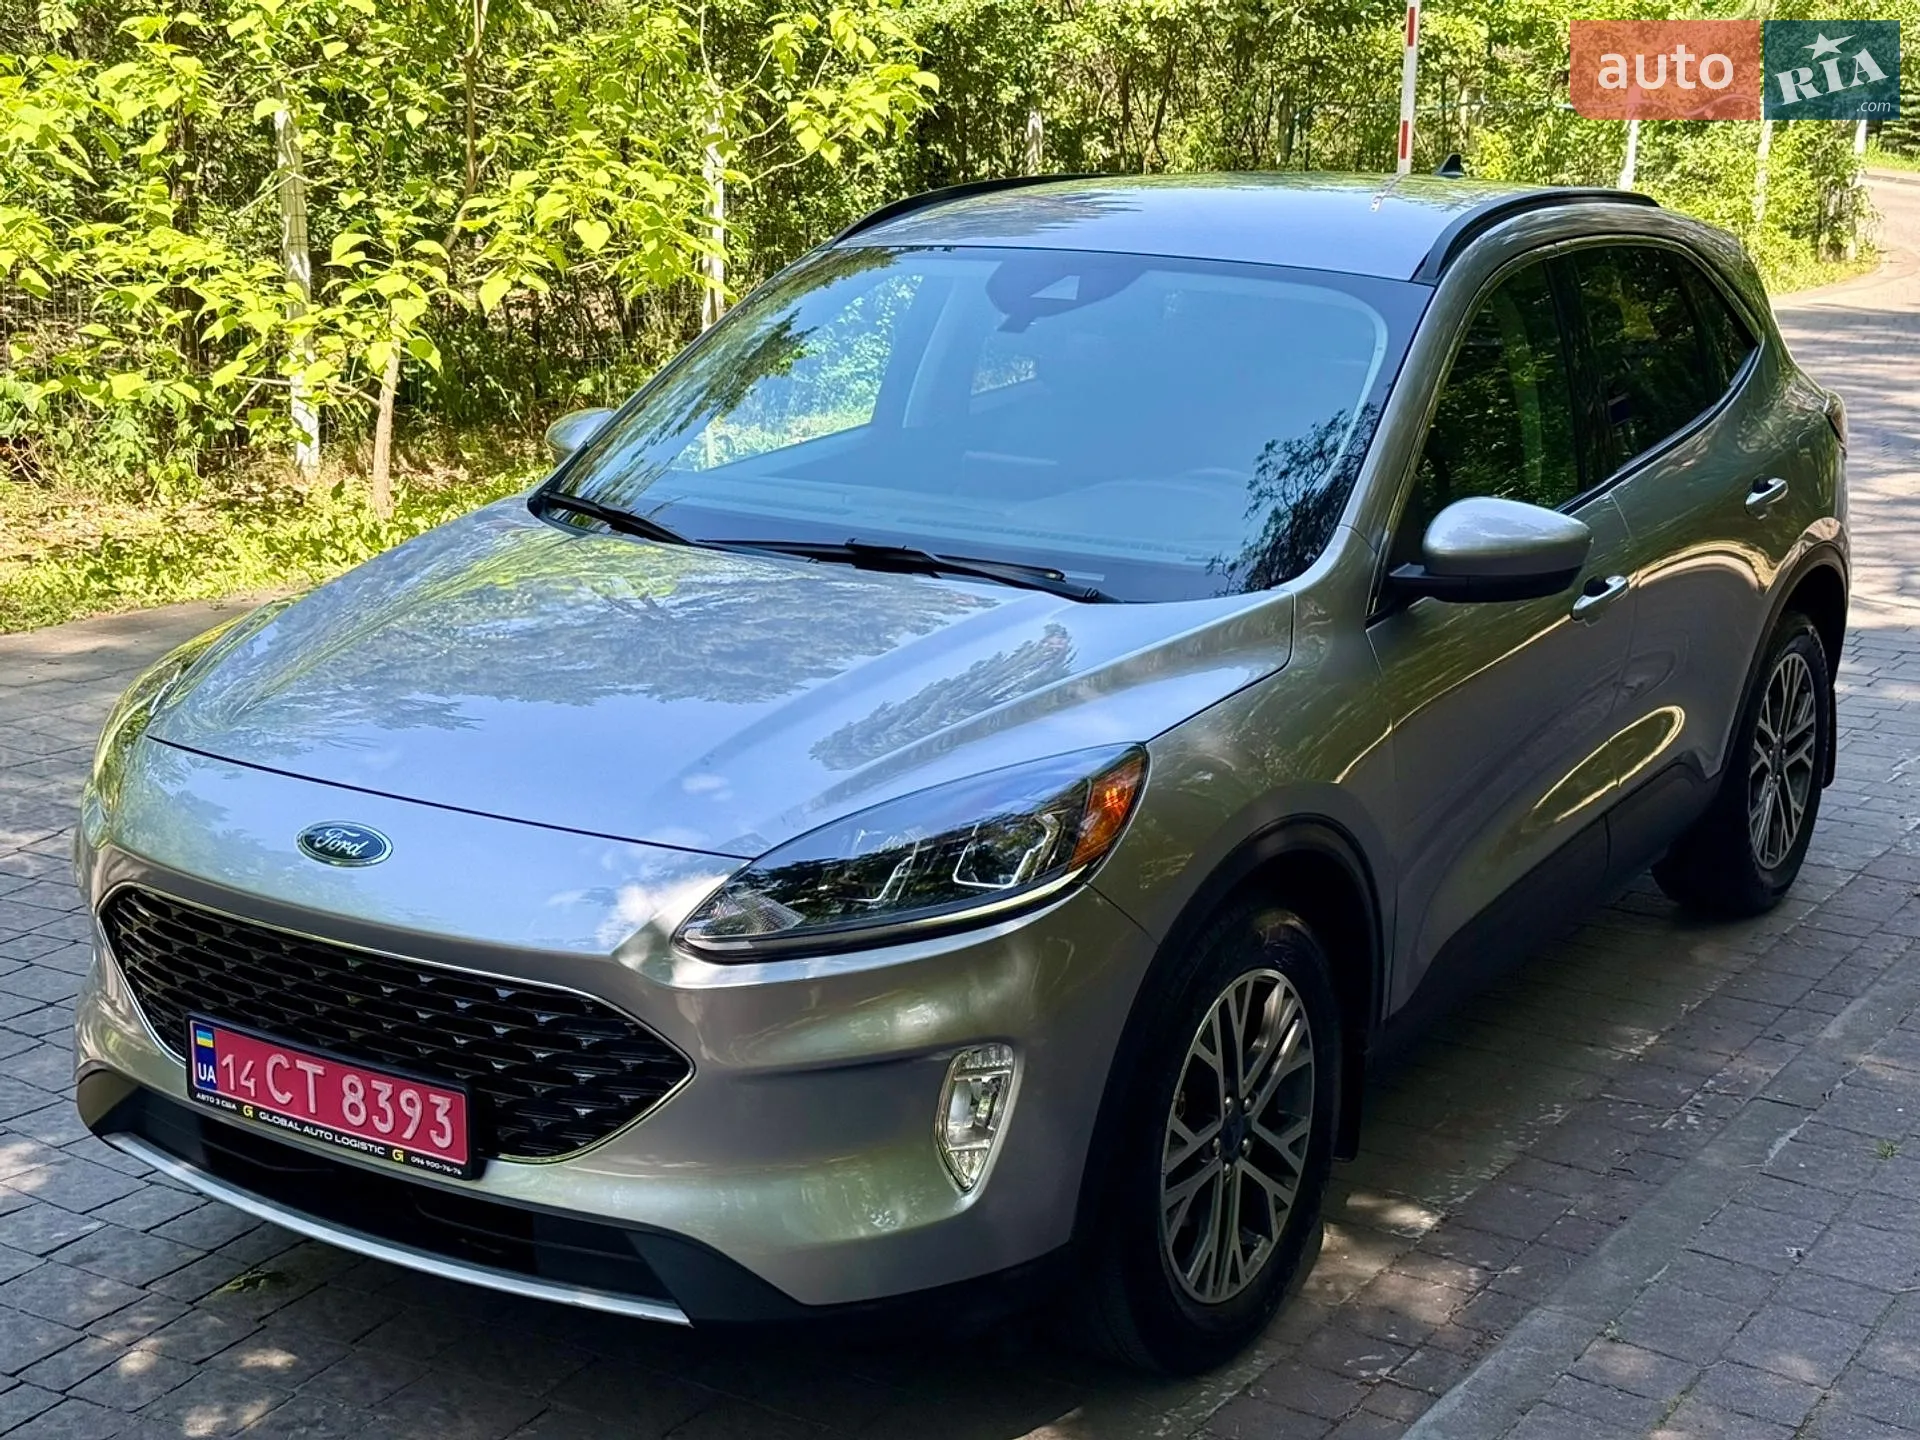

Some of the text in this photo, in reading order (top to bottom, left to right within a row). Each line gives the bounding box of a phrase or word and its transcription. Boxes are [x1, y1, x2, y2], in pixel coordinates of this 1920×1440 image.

[313, 828, 369, 857] Ford
[198, 1062, 217, 1085] UA
[341, 1074, 453, 1148] 8393
[258, 1111, 301, 1131] GLOBAL
[303, 1125, 333, 1140] AUTO
[334, 1134, 385, 1155] LOGISTIC
